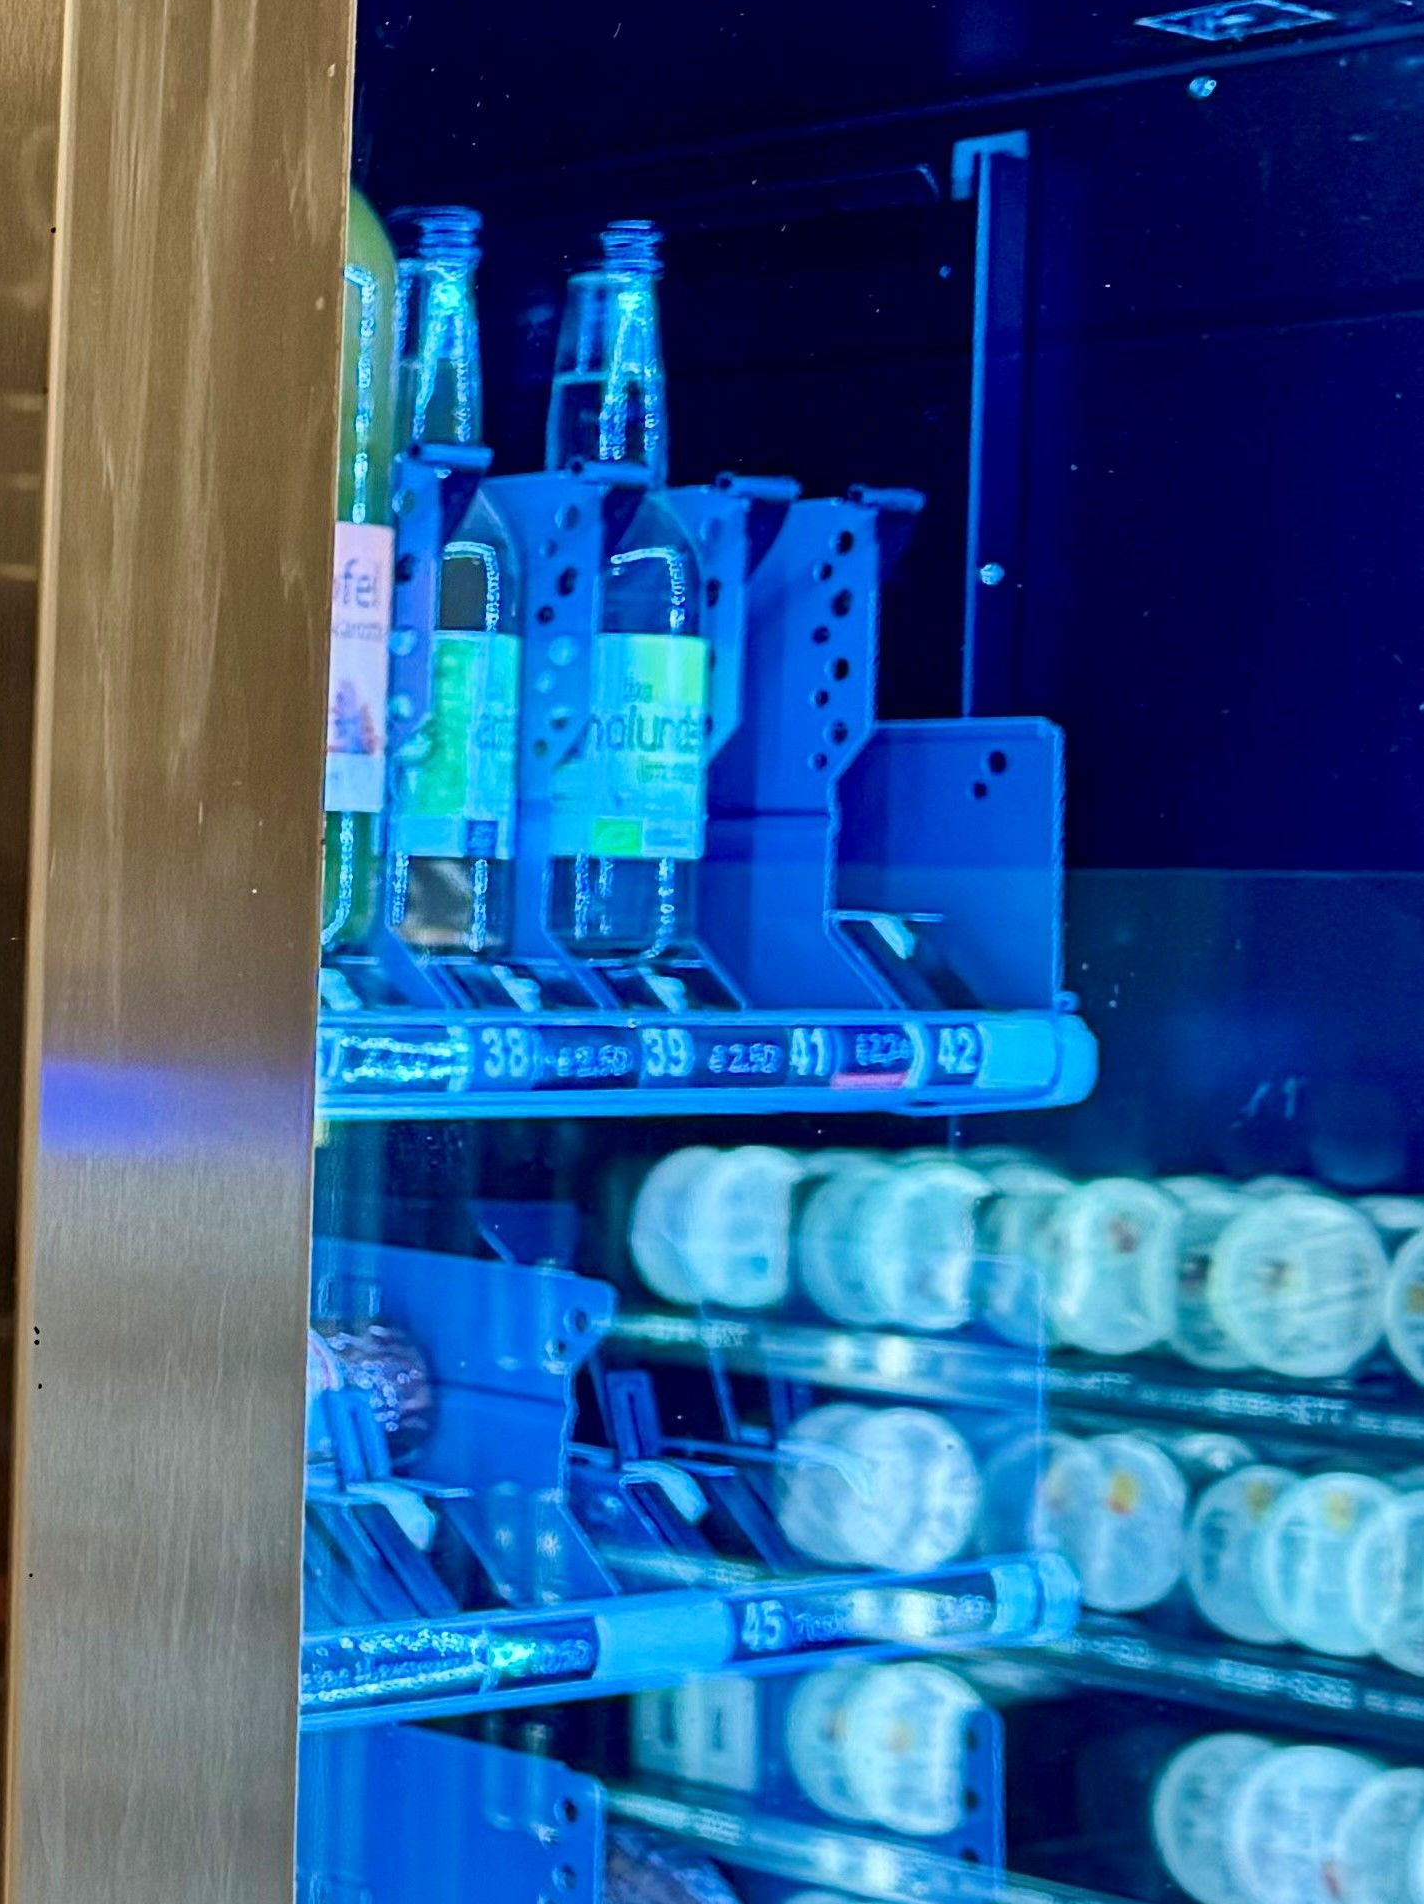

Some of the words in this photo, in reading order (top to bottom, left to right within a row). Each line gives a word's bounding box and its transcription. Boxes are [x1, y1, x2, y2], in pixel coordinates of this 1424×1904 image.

[481, 1027, 530, 1078] 38
[642, 1027, 688, 1077] 39
[789, 1027, 826, 1076] 41
[937, 1026, 977, 1075] 42
[741, 1598, 785, 1653] 45
